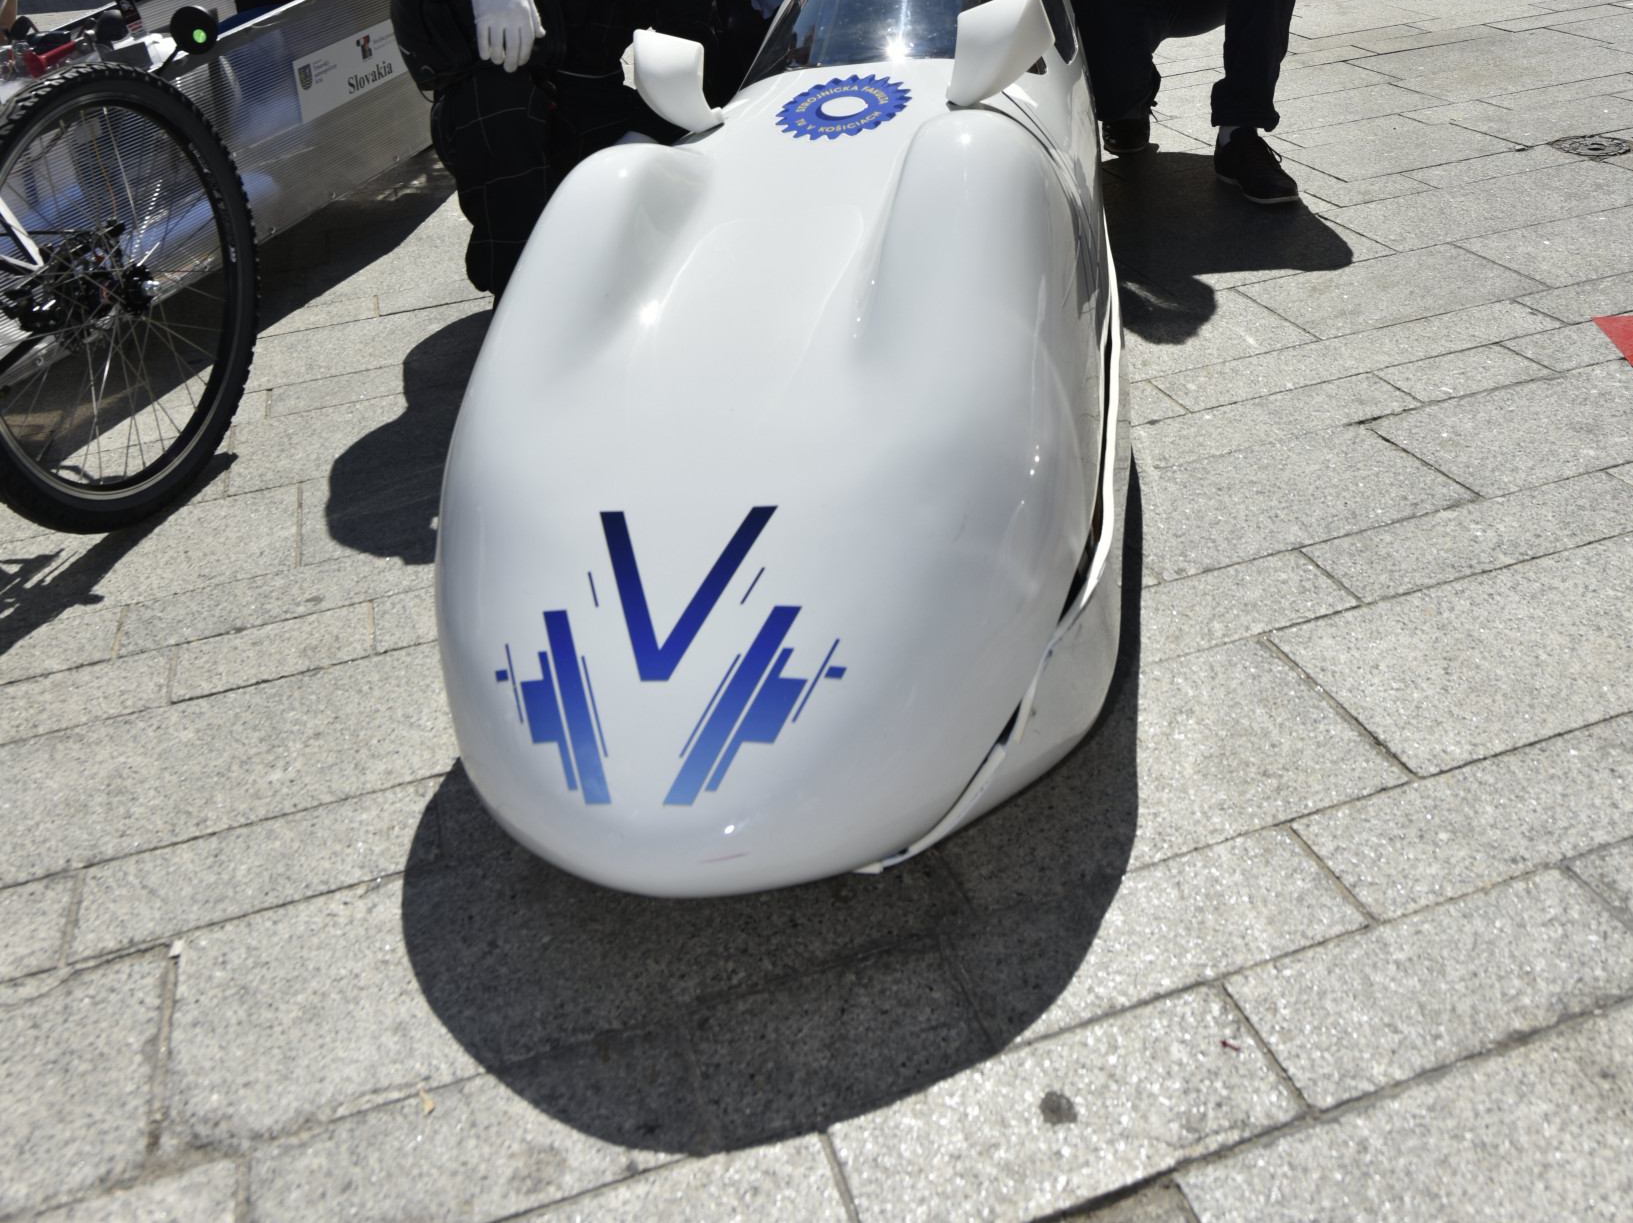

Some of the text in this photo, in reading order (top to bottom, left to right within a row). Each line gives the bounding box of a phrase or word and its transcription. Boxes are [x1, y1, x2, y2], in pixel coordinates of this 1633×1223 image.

[347, 60, 393, 95] Slovakia
[795, 85, 889, 113] STROJNÍCKA FAKULTA
[818, 111, 882, 133] KOŠICIACH
